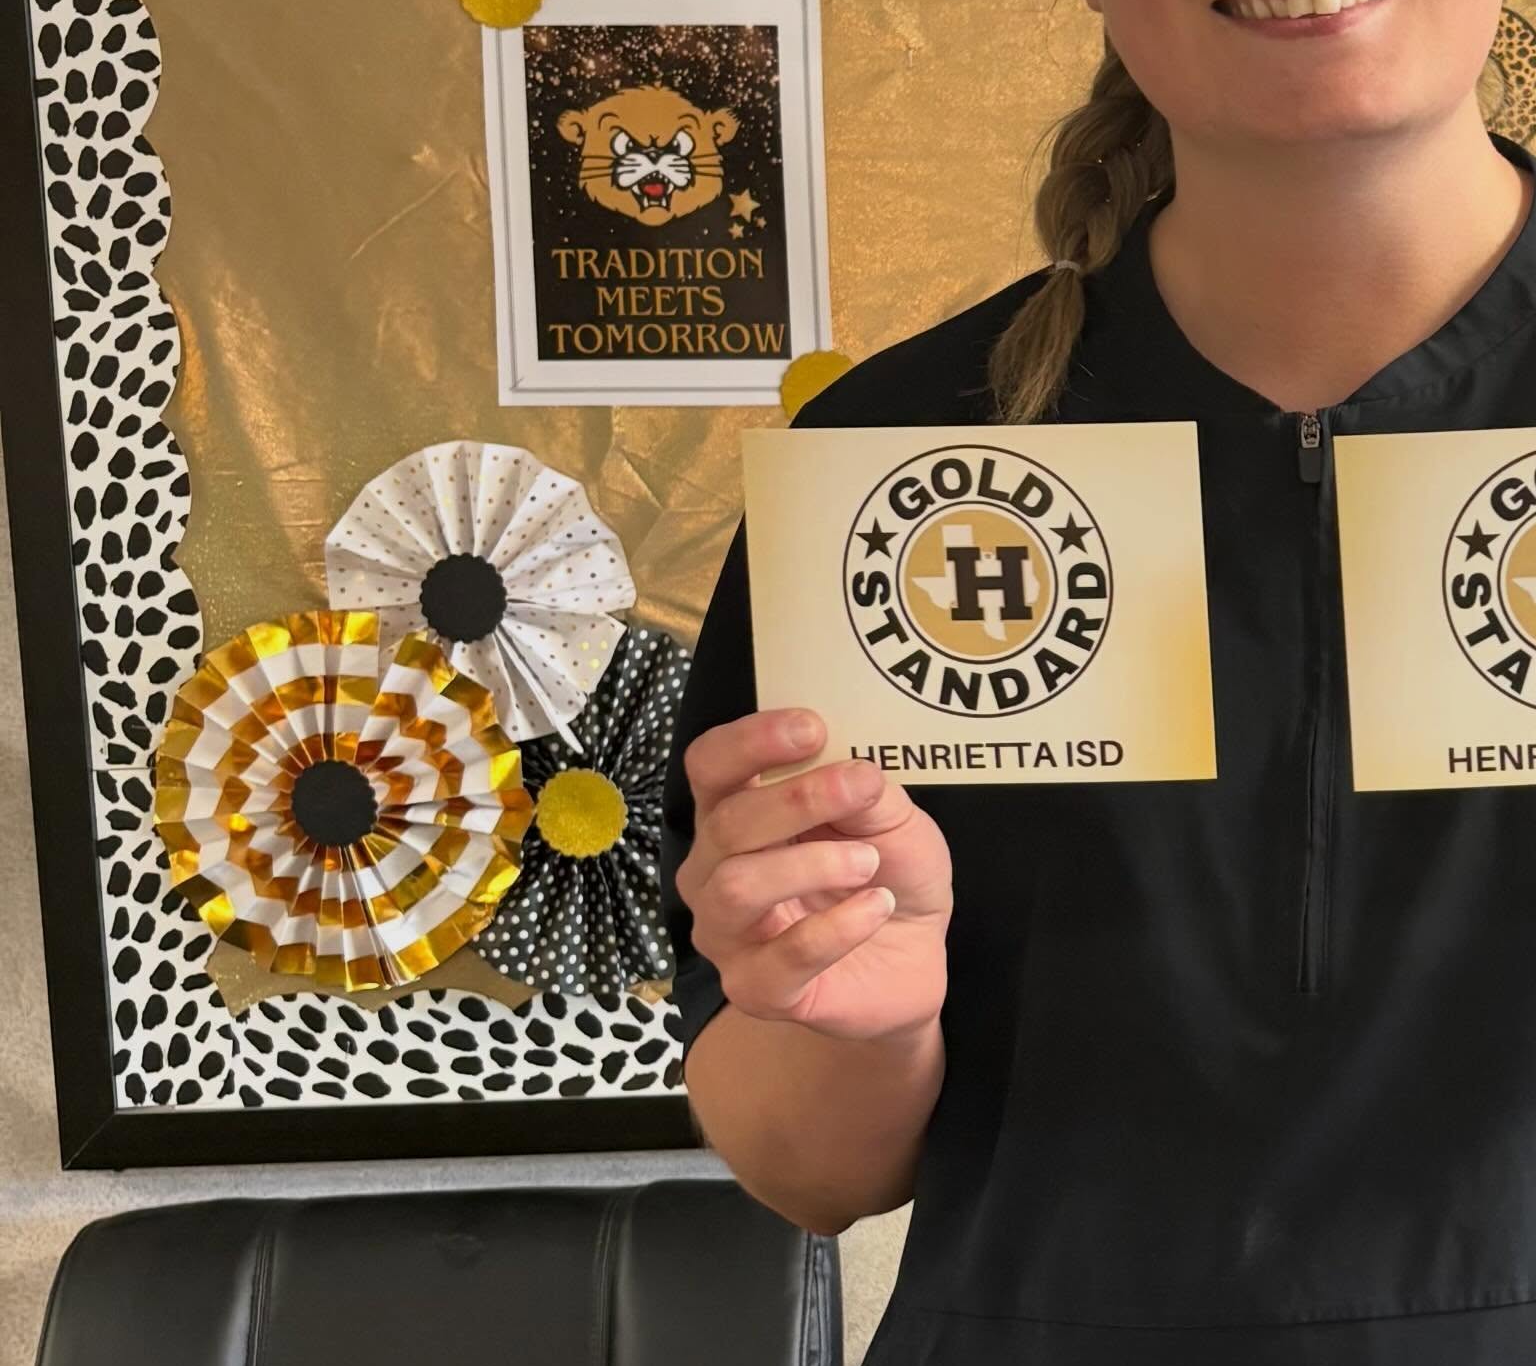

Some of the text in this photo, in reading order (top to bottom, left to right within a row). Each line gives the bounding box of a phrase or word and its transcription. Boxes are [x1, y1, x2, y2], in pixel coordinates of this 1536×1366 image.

[552, 248, 765, 279] TRADITION
[596, 285, 727, 317] MEETS
[548, 322, 786, 354] TOMORROW
[888, 457, 1054, 521] GOLD
[946, 545, 1033, 621] H
[852, 561, 1108, 711] STANDARD
[1066, 739, 1124, 767] ISD
